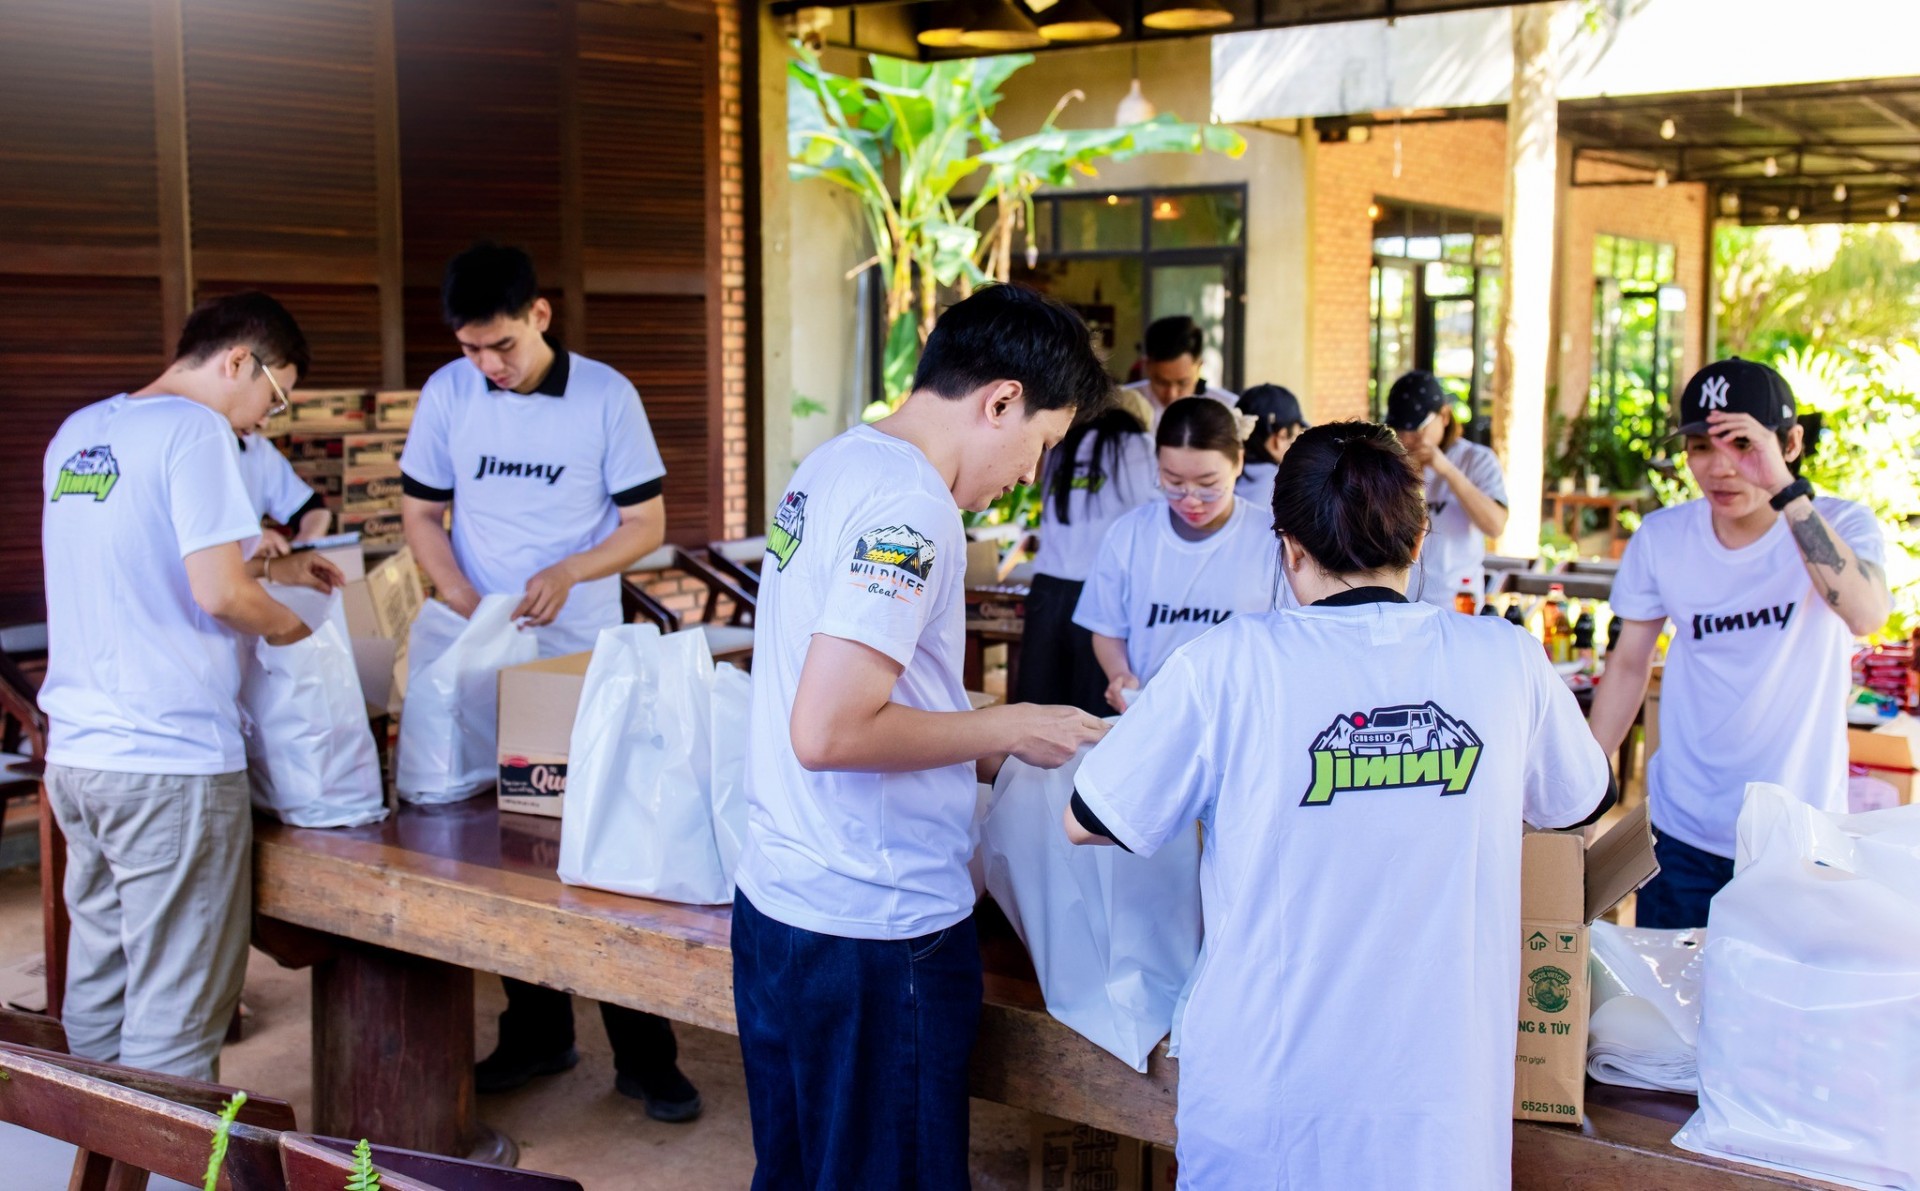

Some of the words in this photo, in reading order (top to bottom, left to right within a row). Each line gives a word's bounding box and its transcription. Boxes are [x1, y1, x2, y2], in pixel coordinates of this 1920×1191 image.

[474, 455, 566, 485] Jimny
[850, 562, 925, 597] WILDLIFE
[867, 582, 898, 599] Real
[1692, 602, 1796, 640] Jimny
[1300, 745, 1484, 807] Jimny
[1530, 941, 1547, 951] UP
[1538, 1022, 1547, 1034] &
[1521, 1101, 1576, 1115] 65251308
